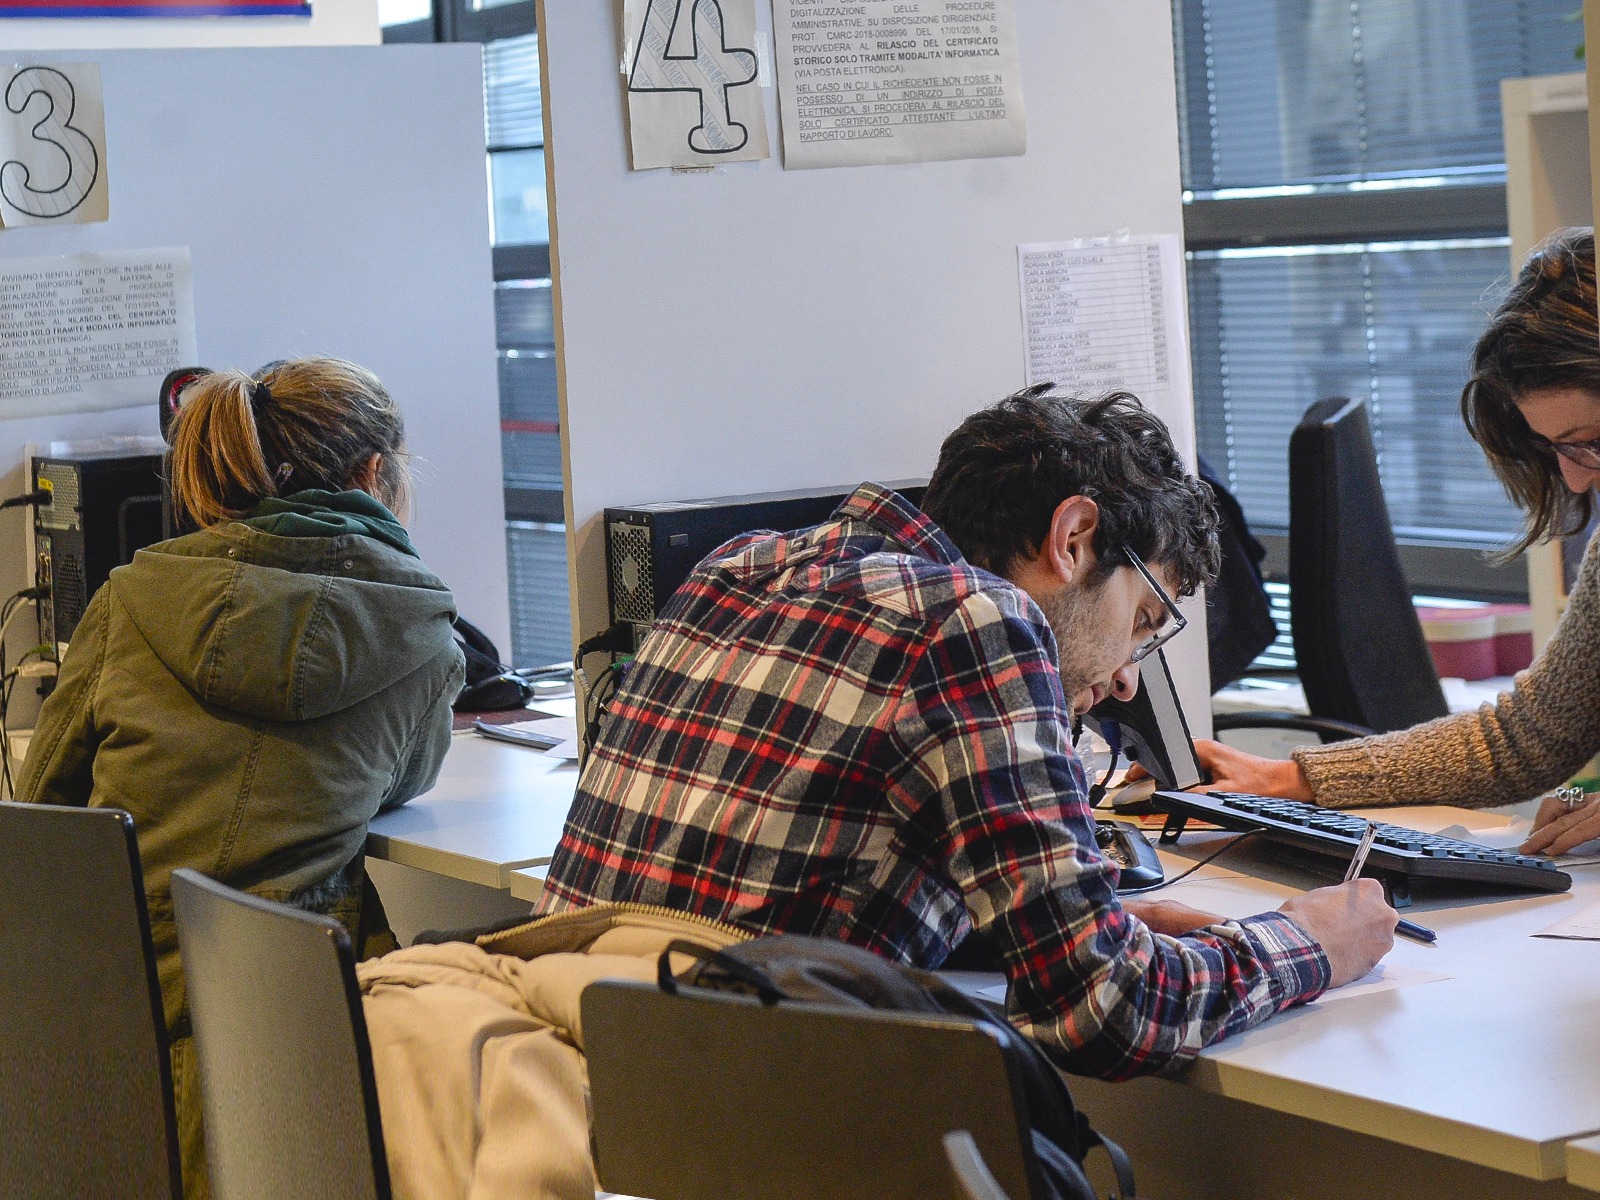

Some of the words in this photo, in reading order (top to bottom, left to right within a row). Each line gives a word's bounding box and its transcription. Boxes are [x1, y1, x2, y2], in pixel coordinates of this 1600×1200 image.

[790, 6, 867, 17] DIGITALIZZAZIONE
[894, 5, 919, 13] DELLE
[946, 2, 996, 11] PROCEDURE
[868, 18, 879, 26] SU
[883, 15, 939, 26] DISPOSIZIONE
[942, 13, 997, 23] DIRIGENZIALE
[916, 28, 932, 36] DEL
[860, 42, 870, 50] AL
[877, 40, 916, 49] RILASCIO
[923, 39, 940, 47] DEL
[946, 37, 998, 46] CERTIFICATO
[794, 56, 832, 65] STORICO
[834, 55, 857, 63] SOLO
[860, 53, 895, 63] TRAMITE
[945, 48, 1000, 58] INFORMATICA
[628, 0, 758, 154] 4
[795, 69, 812, 79] (VIA
[814, 68, 841, 76] POSTA
[796, 84, 812, 92] NEL
[816, 83, 840, 91] CASO
[843, 82, 852, 90] IN
[855, 81, 870, 89] CUI
[873, 80, 881, 88] IL
[883, 78, 939, 88] RICHIEDENTE
[942, 76, 961, 85] NON
[963, 75, 990, 83] FOSSE
[797, 94, 843, 104] POSSESSO
[856, 93, 865, 101] DI
[877, 92, 889, 100] UN
[902, 89, 943, 98] INDIRIZZO
[955, 88, 964, 96] DI
[976, 86, 1004, 95] POSTA
[862, 105, 870, 113] SI
[932, 101, 943, 109] AL
[947, 99, 984, 108] RILASCIO
[989, 98, 1004, 106] DEL
[799, 120, 822, 129] SOLO
[834, 116, 889, 127] CERTIFICATO
[902, 112, 956, 122] ATTESTANTE
[0, 66, 99, 218] 3
[800, 131, 846, 141] RAPPORTO
[848, 130, 856, 138] DI
